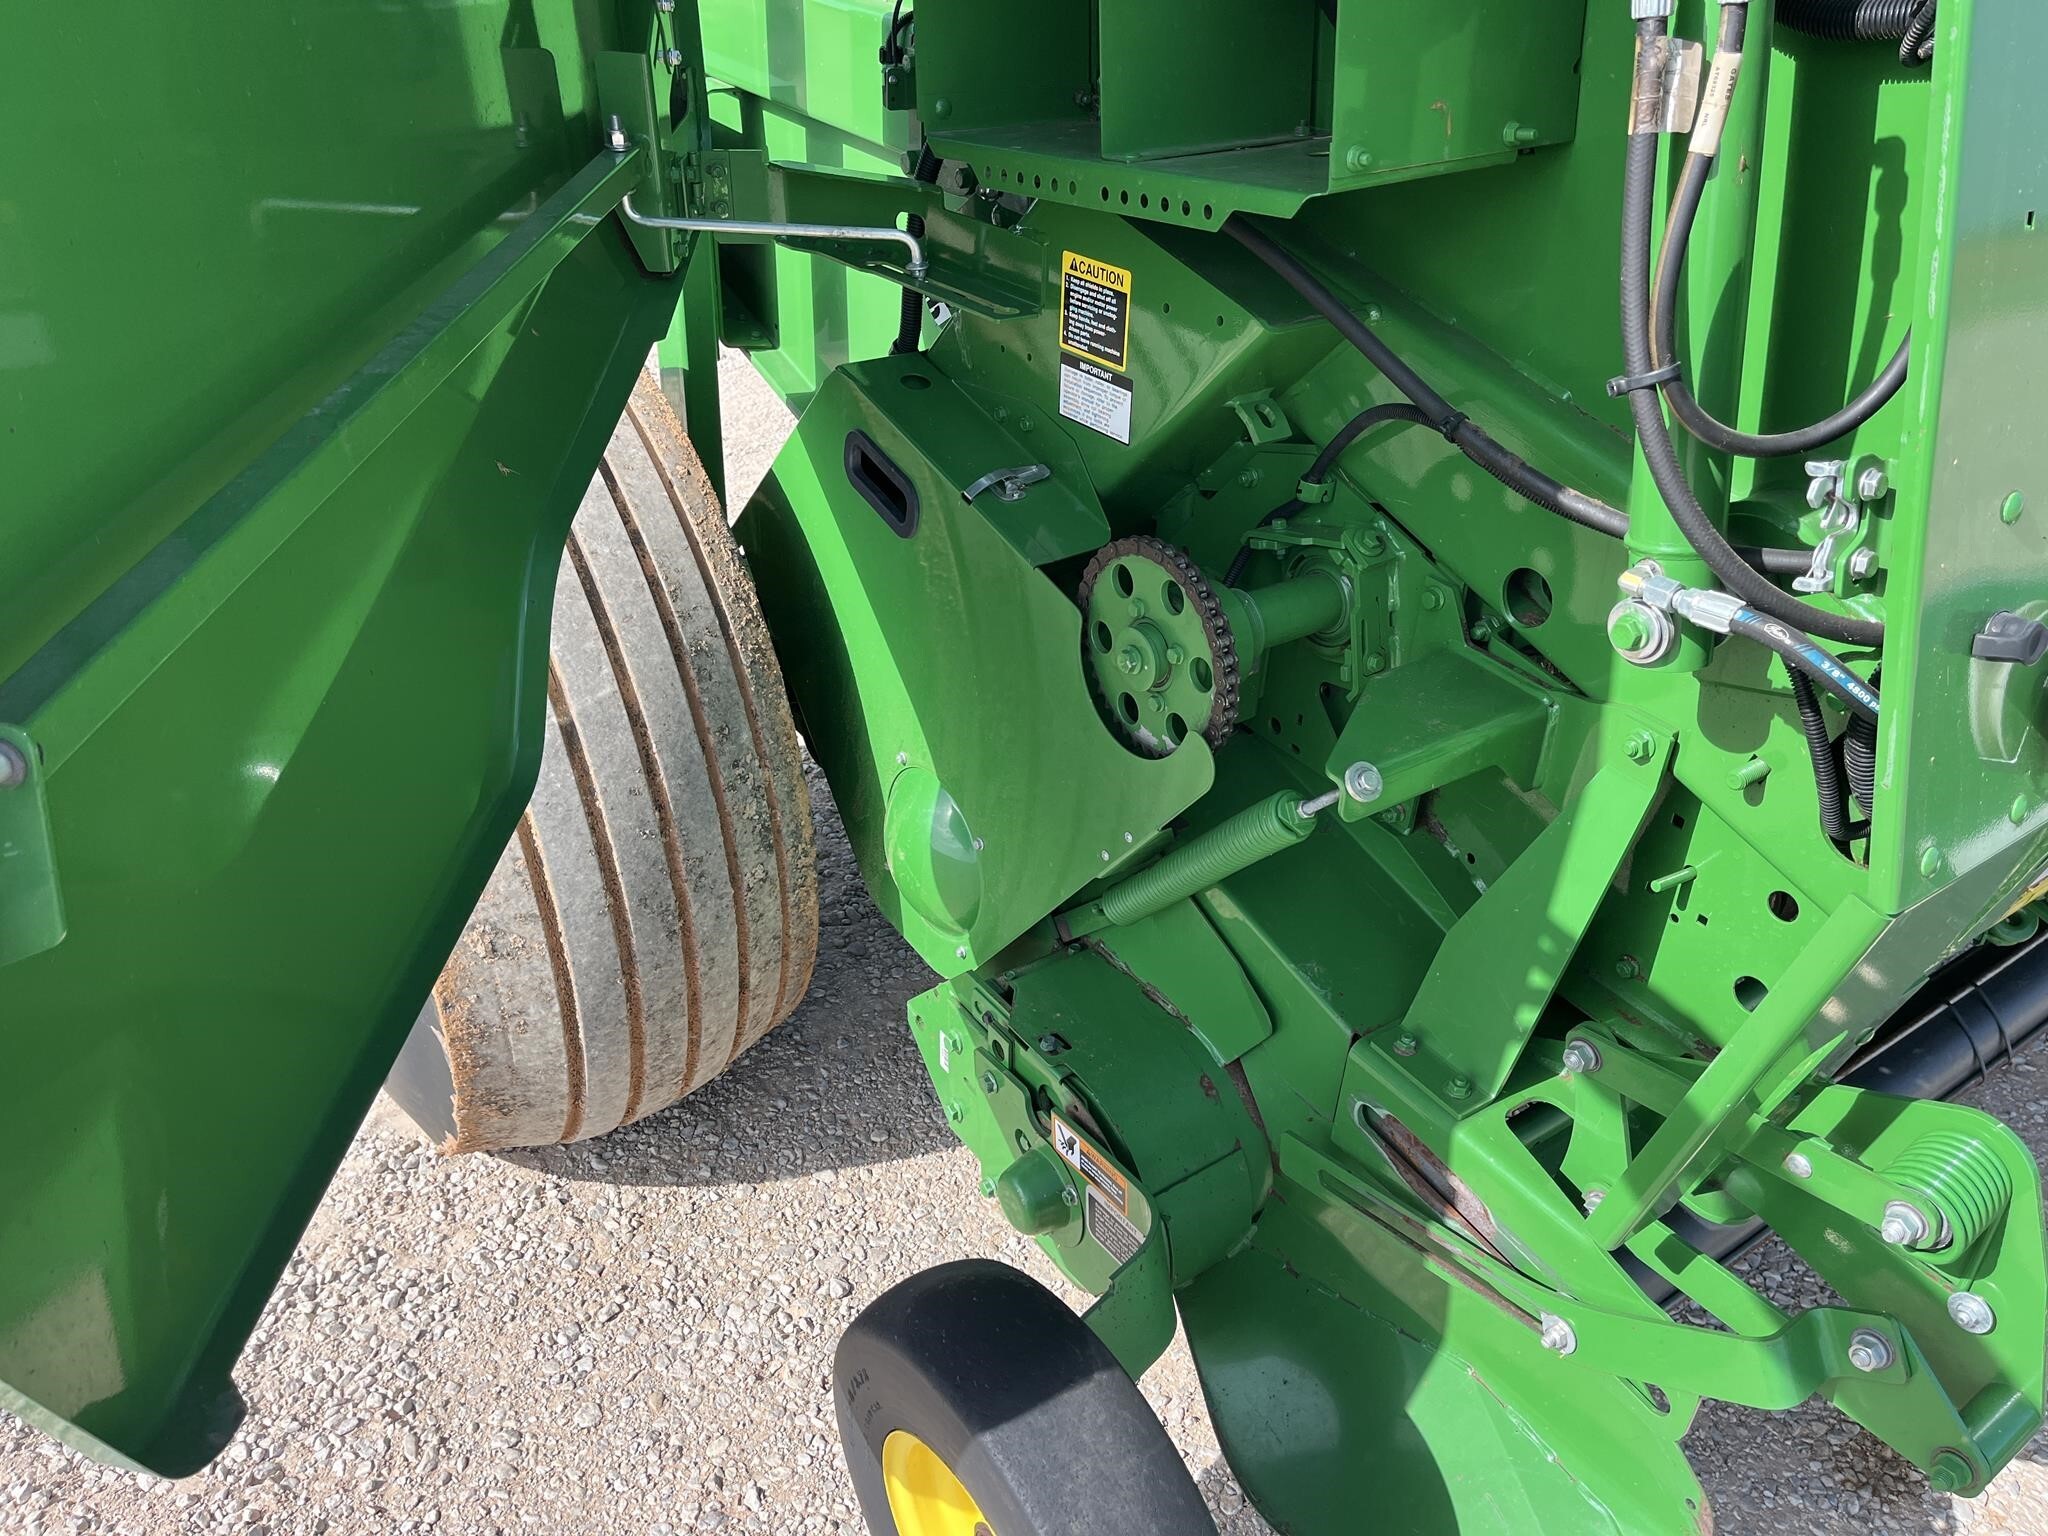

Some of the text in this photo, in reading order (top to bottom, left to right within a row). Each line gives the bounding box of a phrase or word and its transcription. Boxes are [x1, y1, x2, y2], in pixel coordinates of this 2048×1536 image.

[1725, 68, 1737, 101] GATES
[1079, 260, 1124, 287] CAUTION
[1079, 361, 1112, 382] IMPORTANT
[1821, 660, 1846, 679] 3/8"
[1847, 682, 1871, 703] 4800
